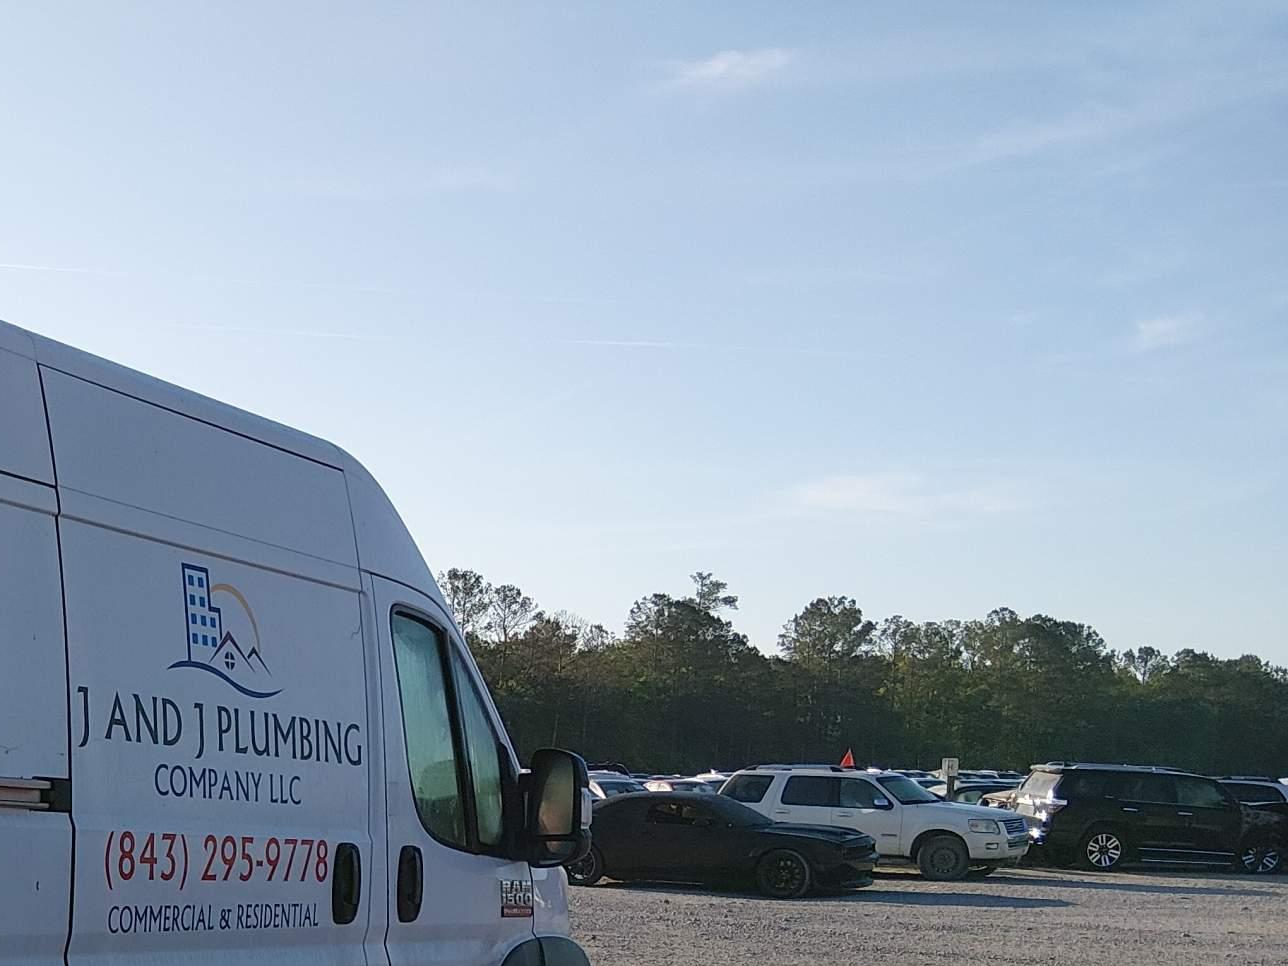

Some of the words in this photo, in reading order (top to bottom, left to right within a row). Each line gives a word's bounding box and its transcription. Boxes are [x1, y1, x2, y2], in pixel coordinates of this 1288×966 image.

[77, 685, 90, 748] J
[104, 691, 183, 746] AND
[193, 702, 205, 759] J
[216, 705, 363, 767] PLUMBING
[154, 763, 263, 802] COMPANY
[269, 773, 302, 805] LLC
[104, 830, 189, 891] (843)
[200, 834, 329, 883] 295-9778
[107, 904, 214, 934] COMMERCIAL
[219, 908, 233, 930] &
[236, 903, 319, 930] RESIDENTIAL
